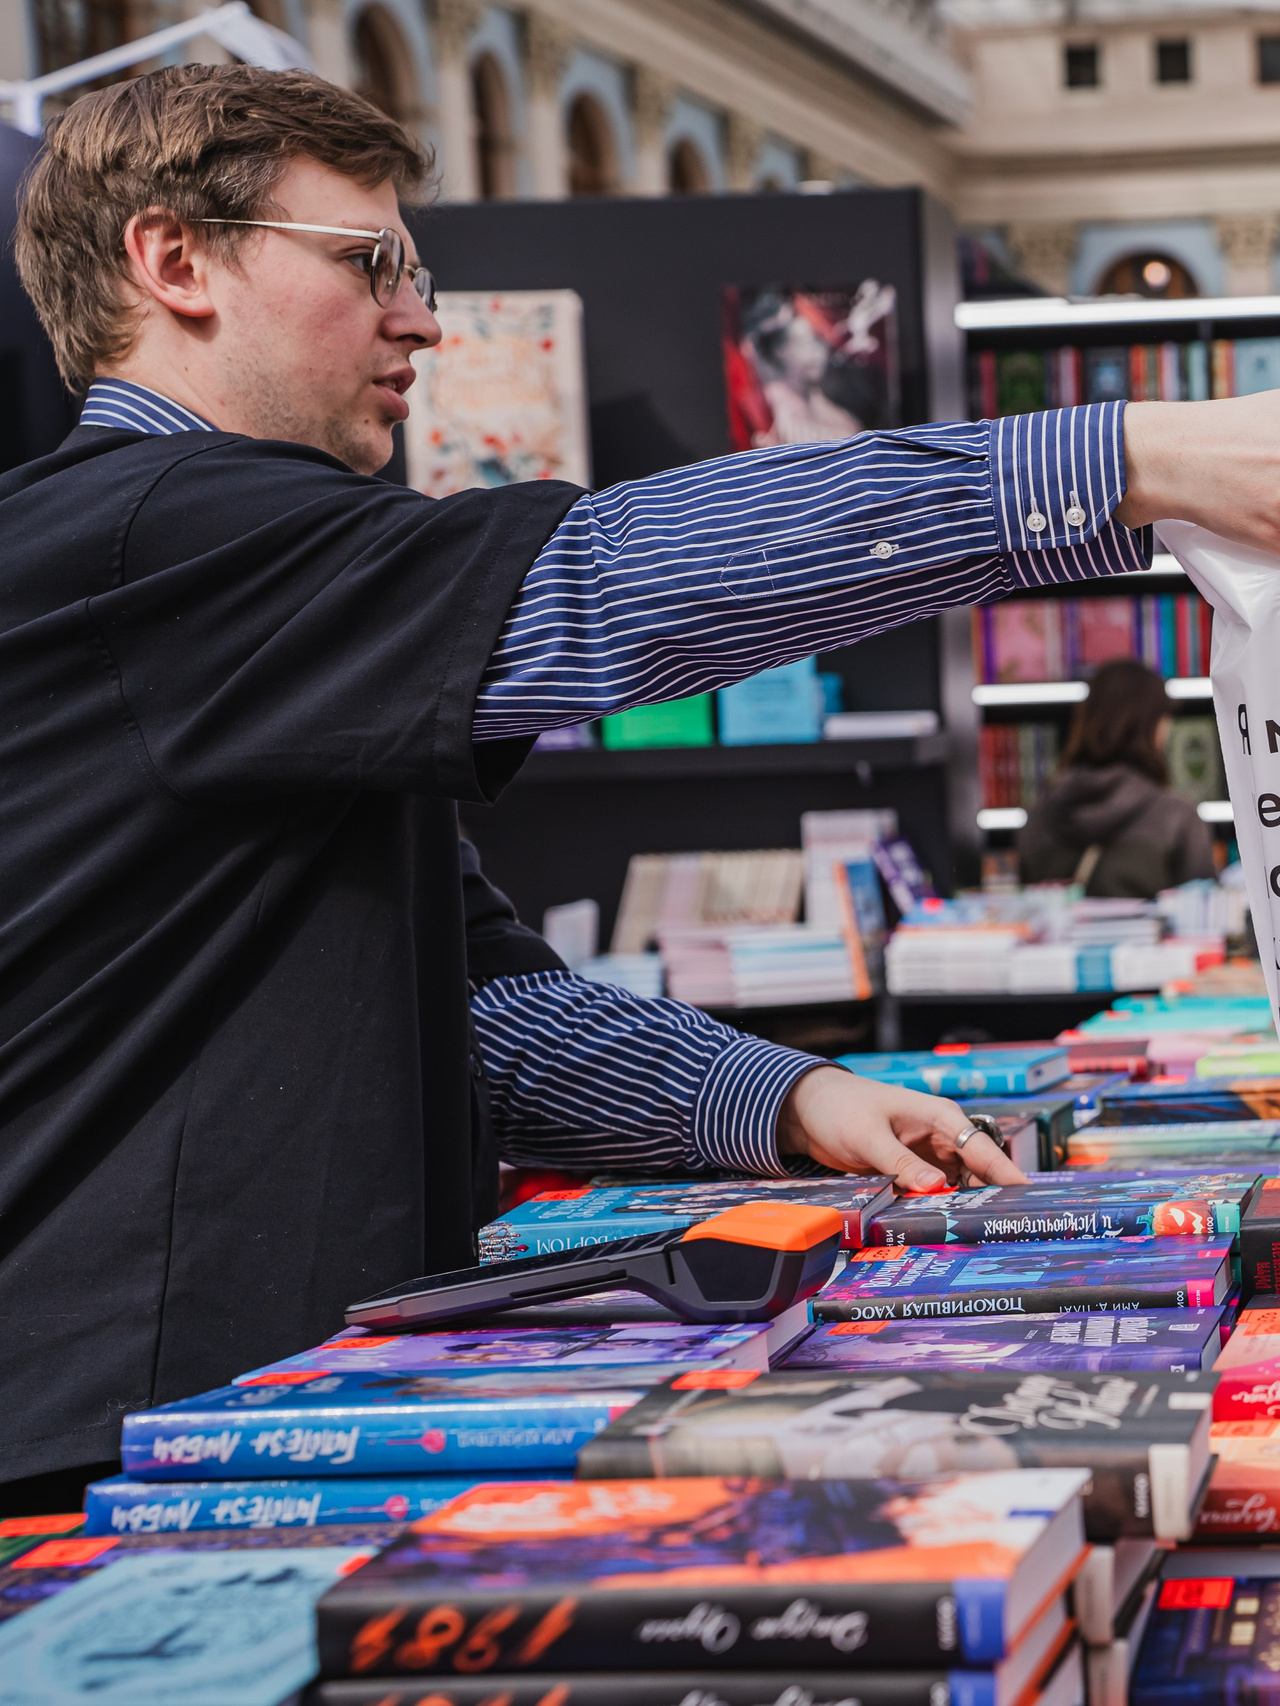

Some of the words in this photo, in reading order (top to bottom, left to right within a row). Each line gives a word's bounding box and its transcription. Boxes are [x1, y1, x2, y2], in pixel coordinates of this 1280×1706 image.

[921, 1258, 956, 1278] ХАОС
[850, 1302, 897, 1321] ХАОС
[902, 1296, 1026, 1318] ПОКОРИВШАЯ
[1112, 1301, 1140, 1311] АМИ
